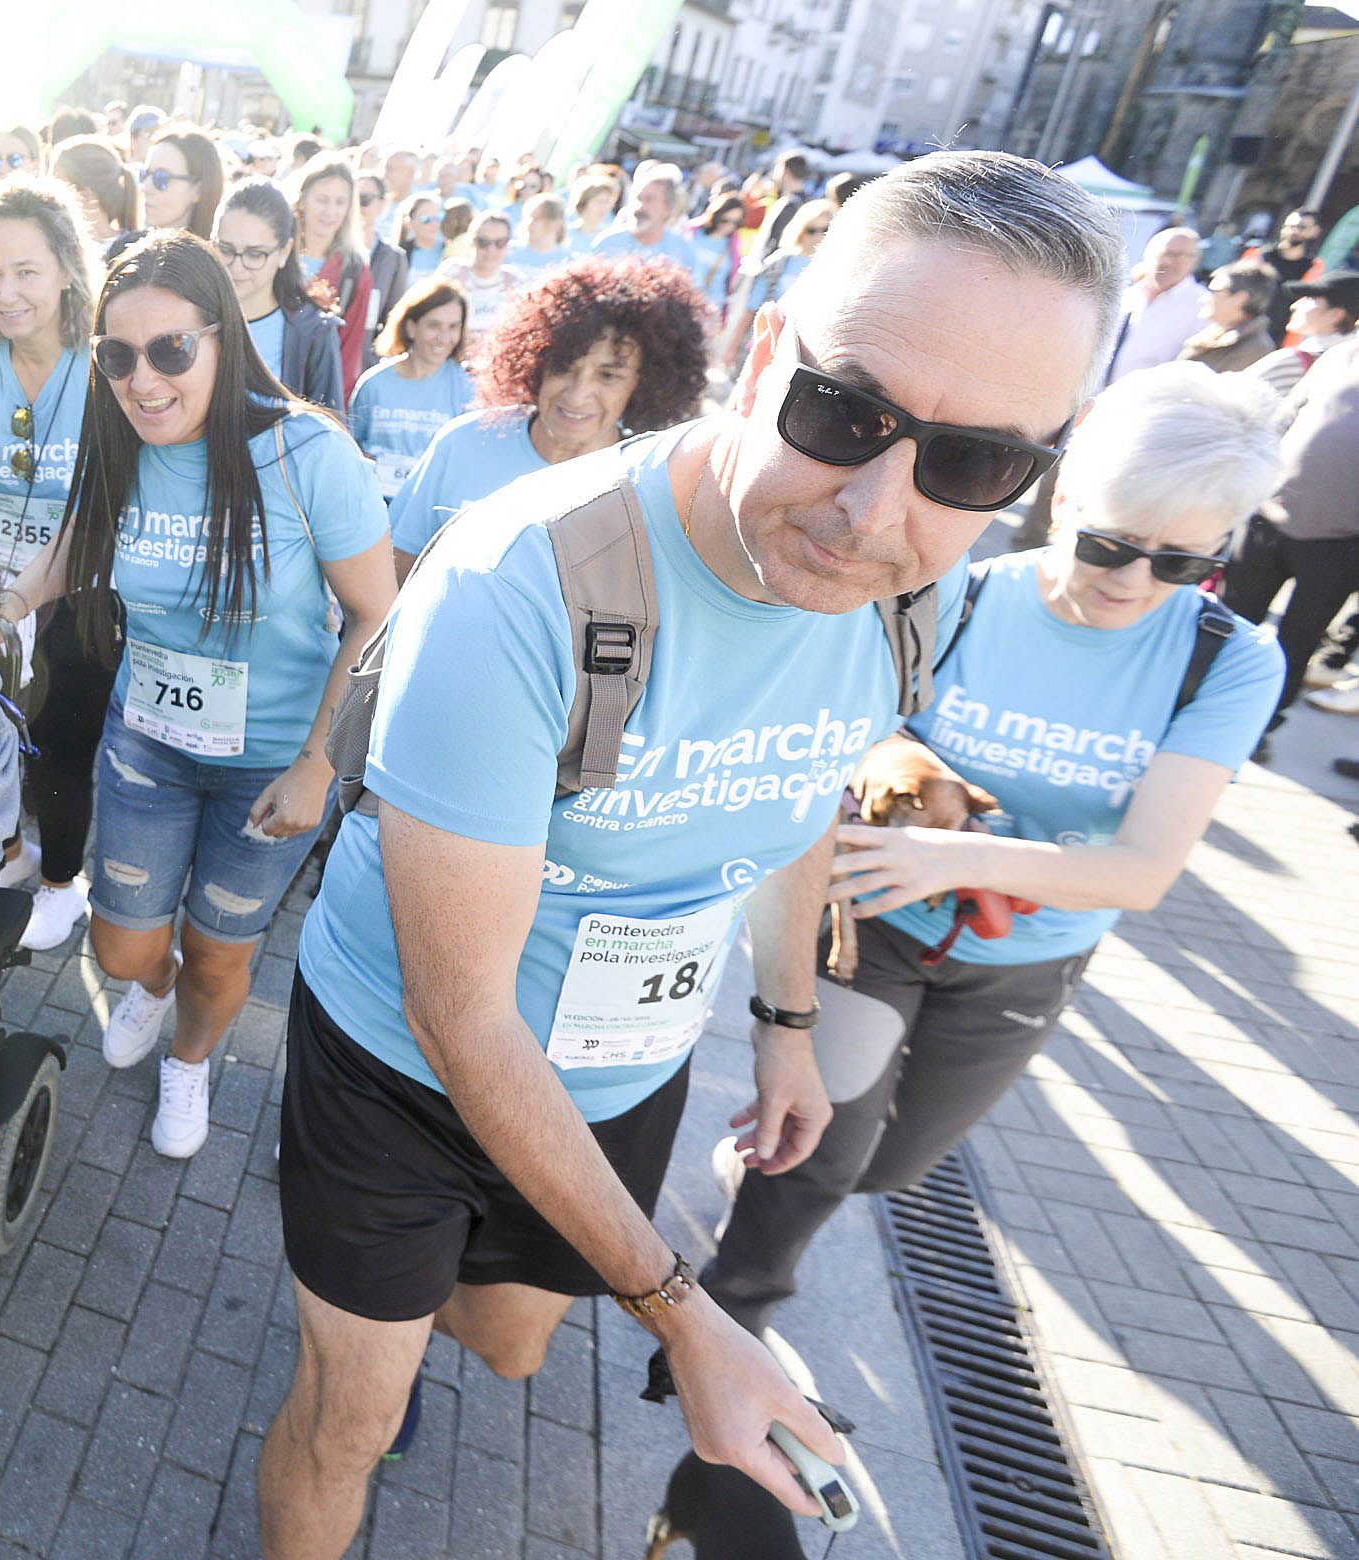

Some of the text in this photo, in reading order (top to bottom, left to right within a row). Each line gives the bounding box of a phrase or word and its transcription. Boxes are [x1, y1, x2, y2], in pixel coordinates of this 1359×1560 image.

[130, 641, 169, 660] Pontevedra
[155, 680, 204, 711] 716
[936, 684, 990, 730] En
[676, 708, 872, 779] marcha
[562, 810, 688, 831] contra o cancro
[588, 920, 685, 937] Pontevedra
[585, 937, 674, 952] en marcha
[580, 951, 619, 963] pola
